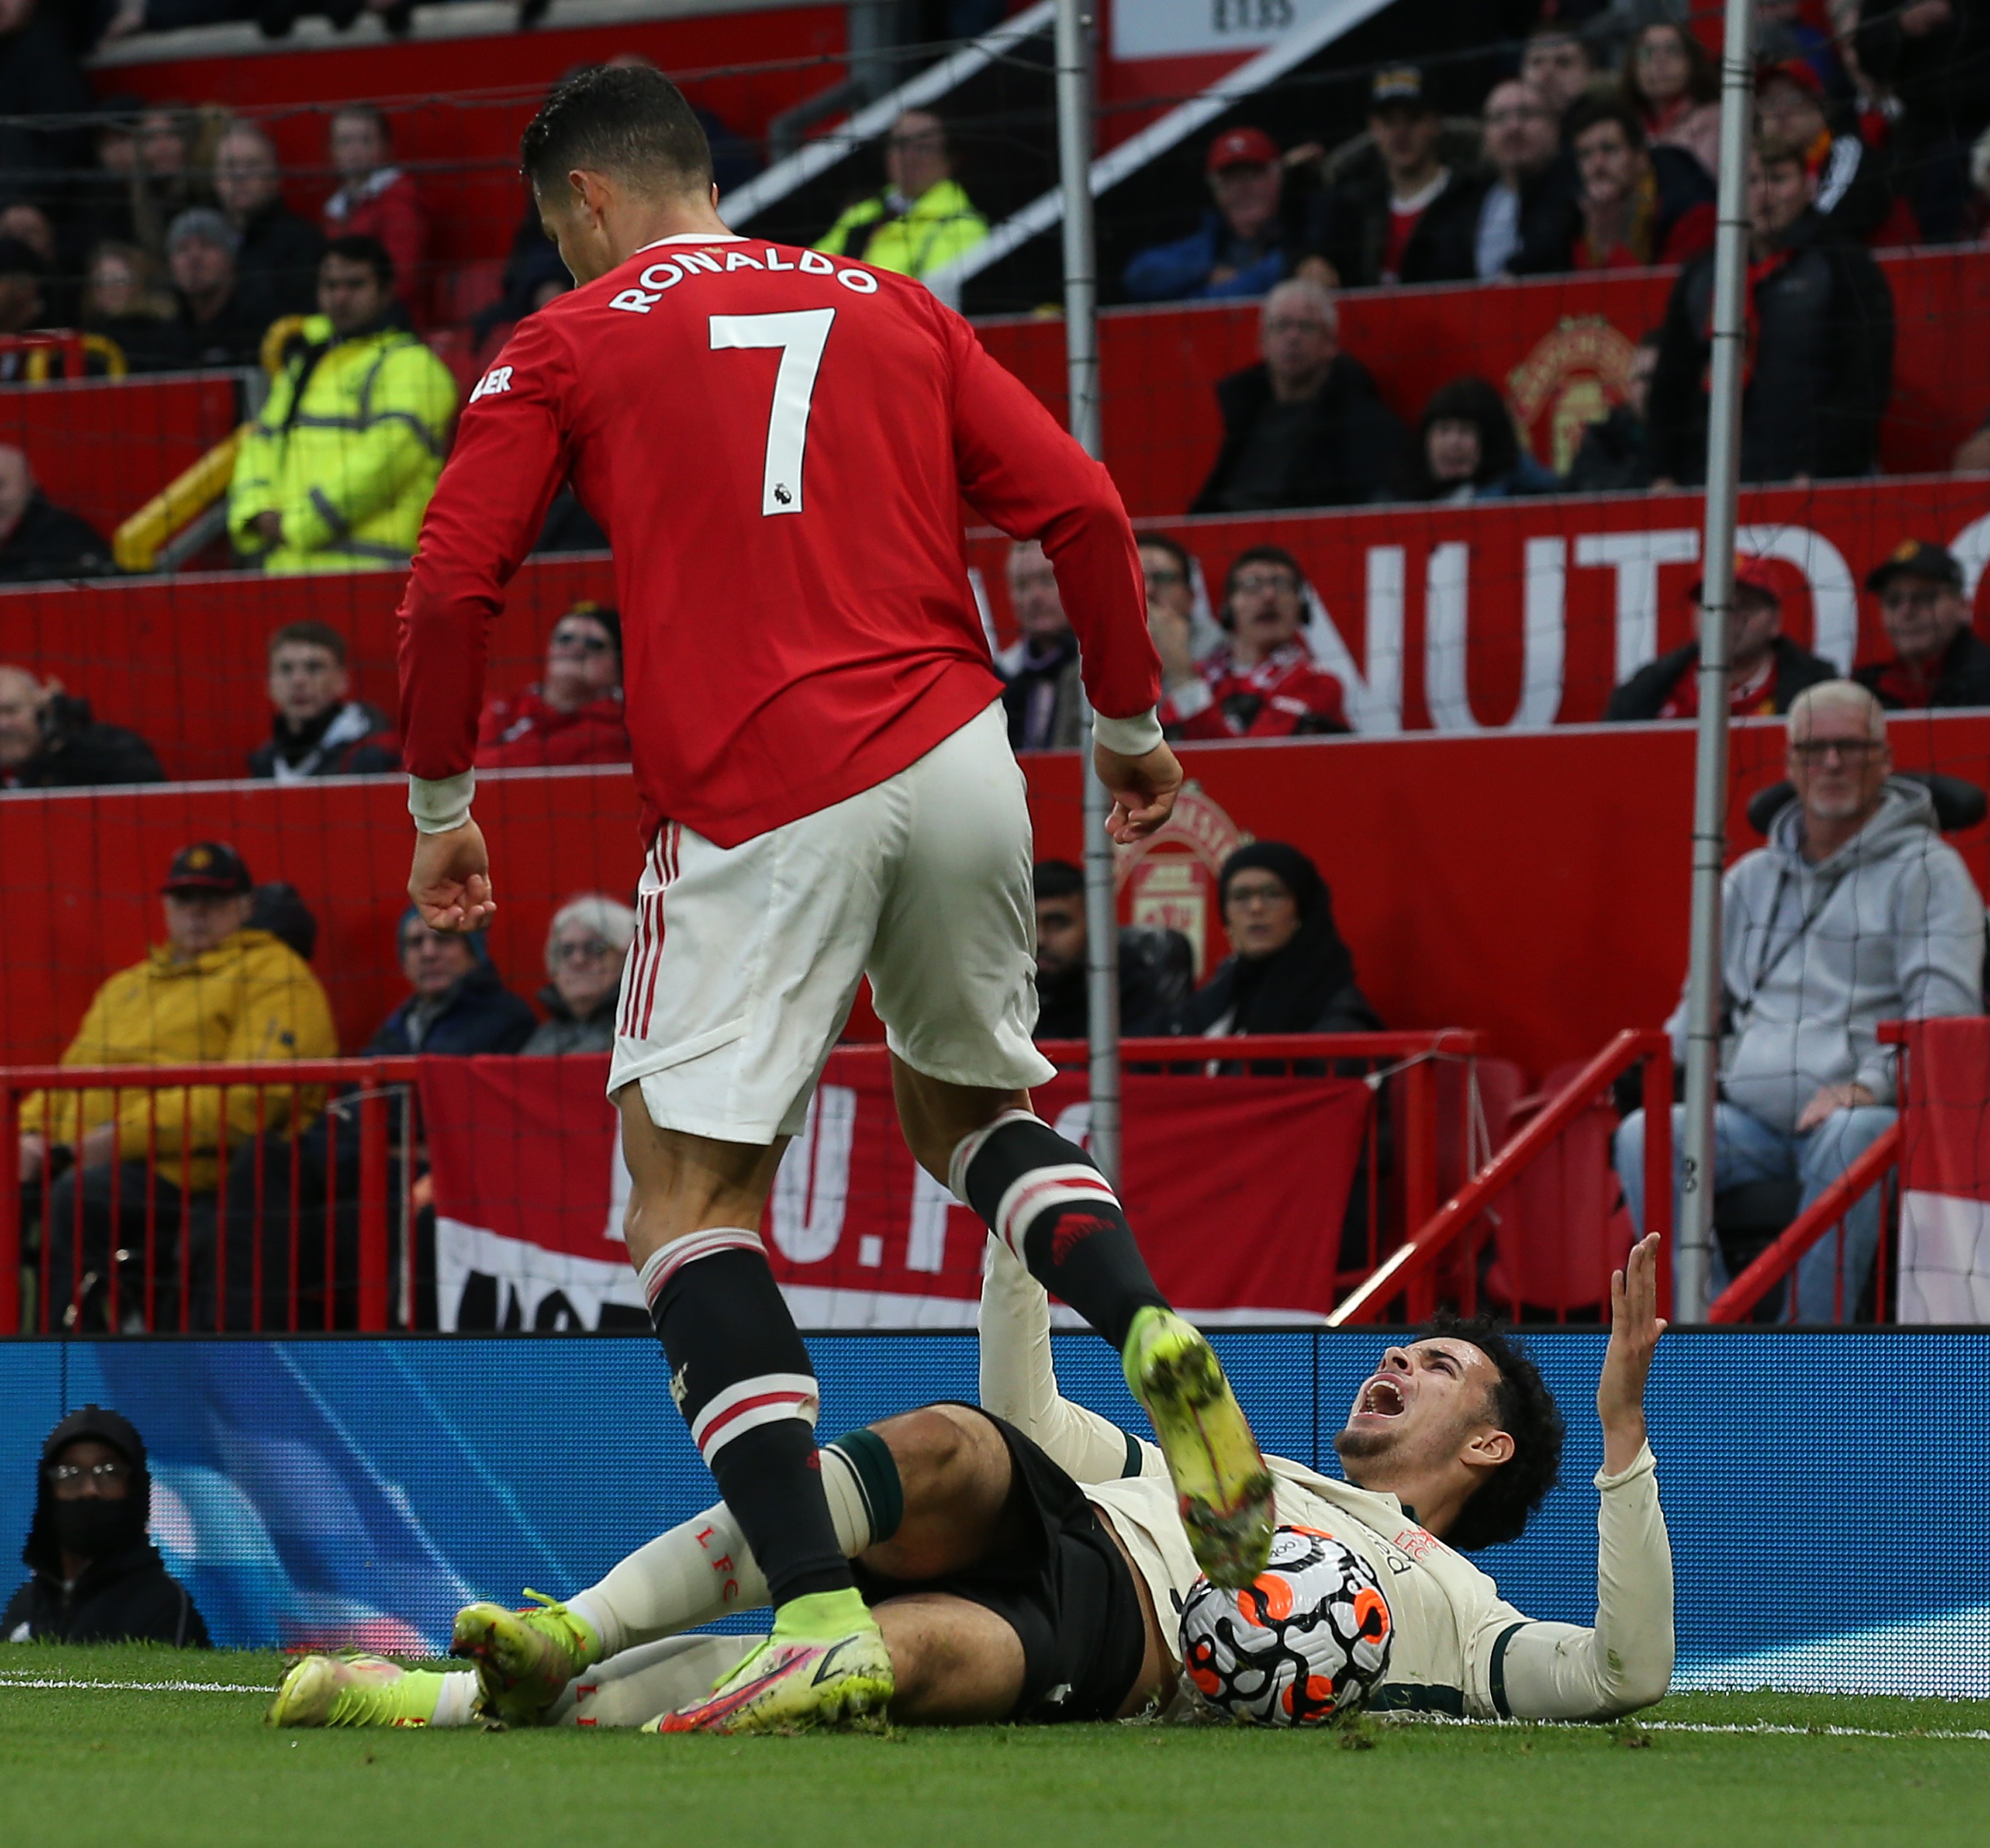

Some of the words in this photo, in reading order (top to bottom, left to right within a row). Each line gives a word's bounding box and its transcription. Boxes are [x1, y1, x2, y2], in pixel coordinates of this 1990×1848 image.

[609, 247, 879, 314] RONALDO
[708, 307, 836, 516] 7
[695, 1526, 740, 1603] LFC
[1393, 1531, 1430, 1561] LFC
